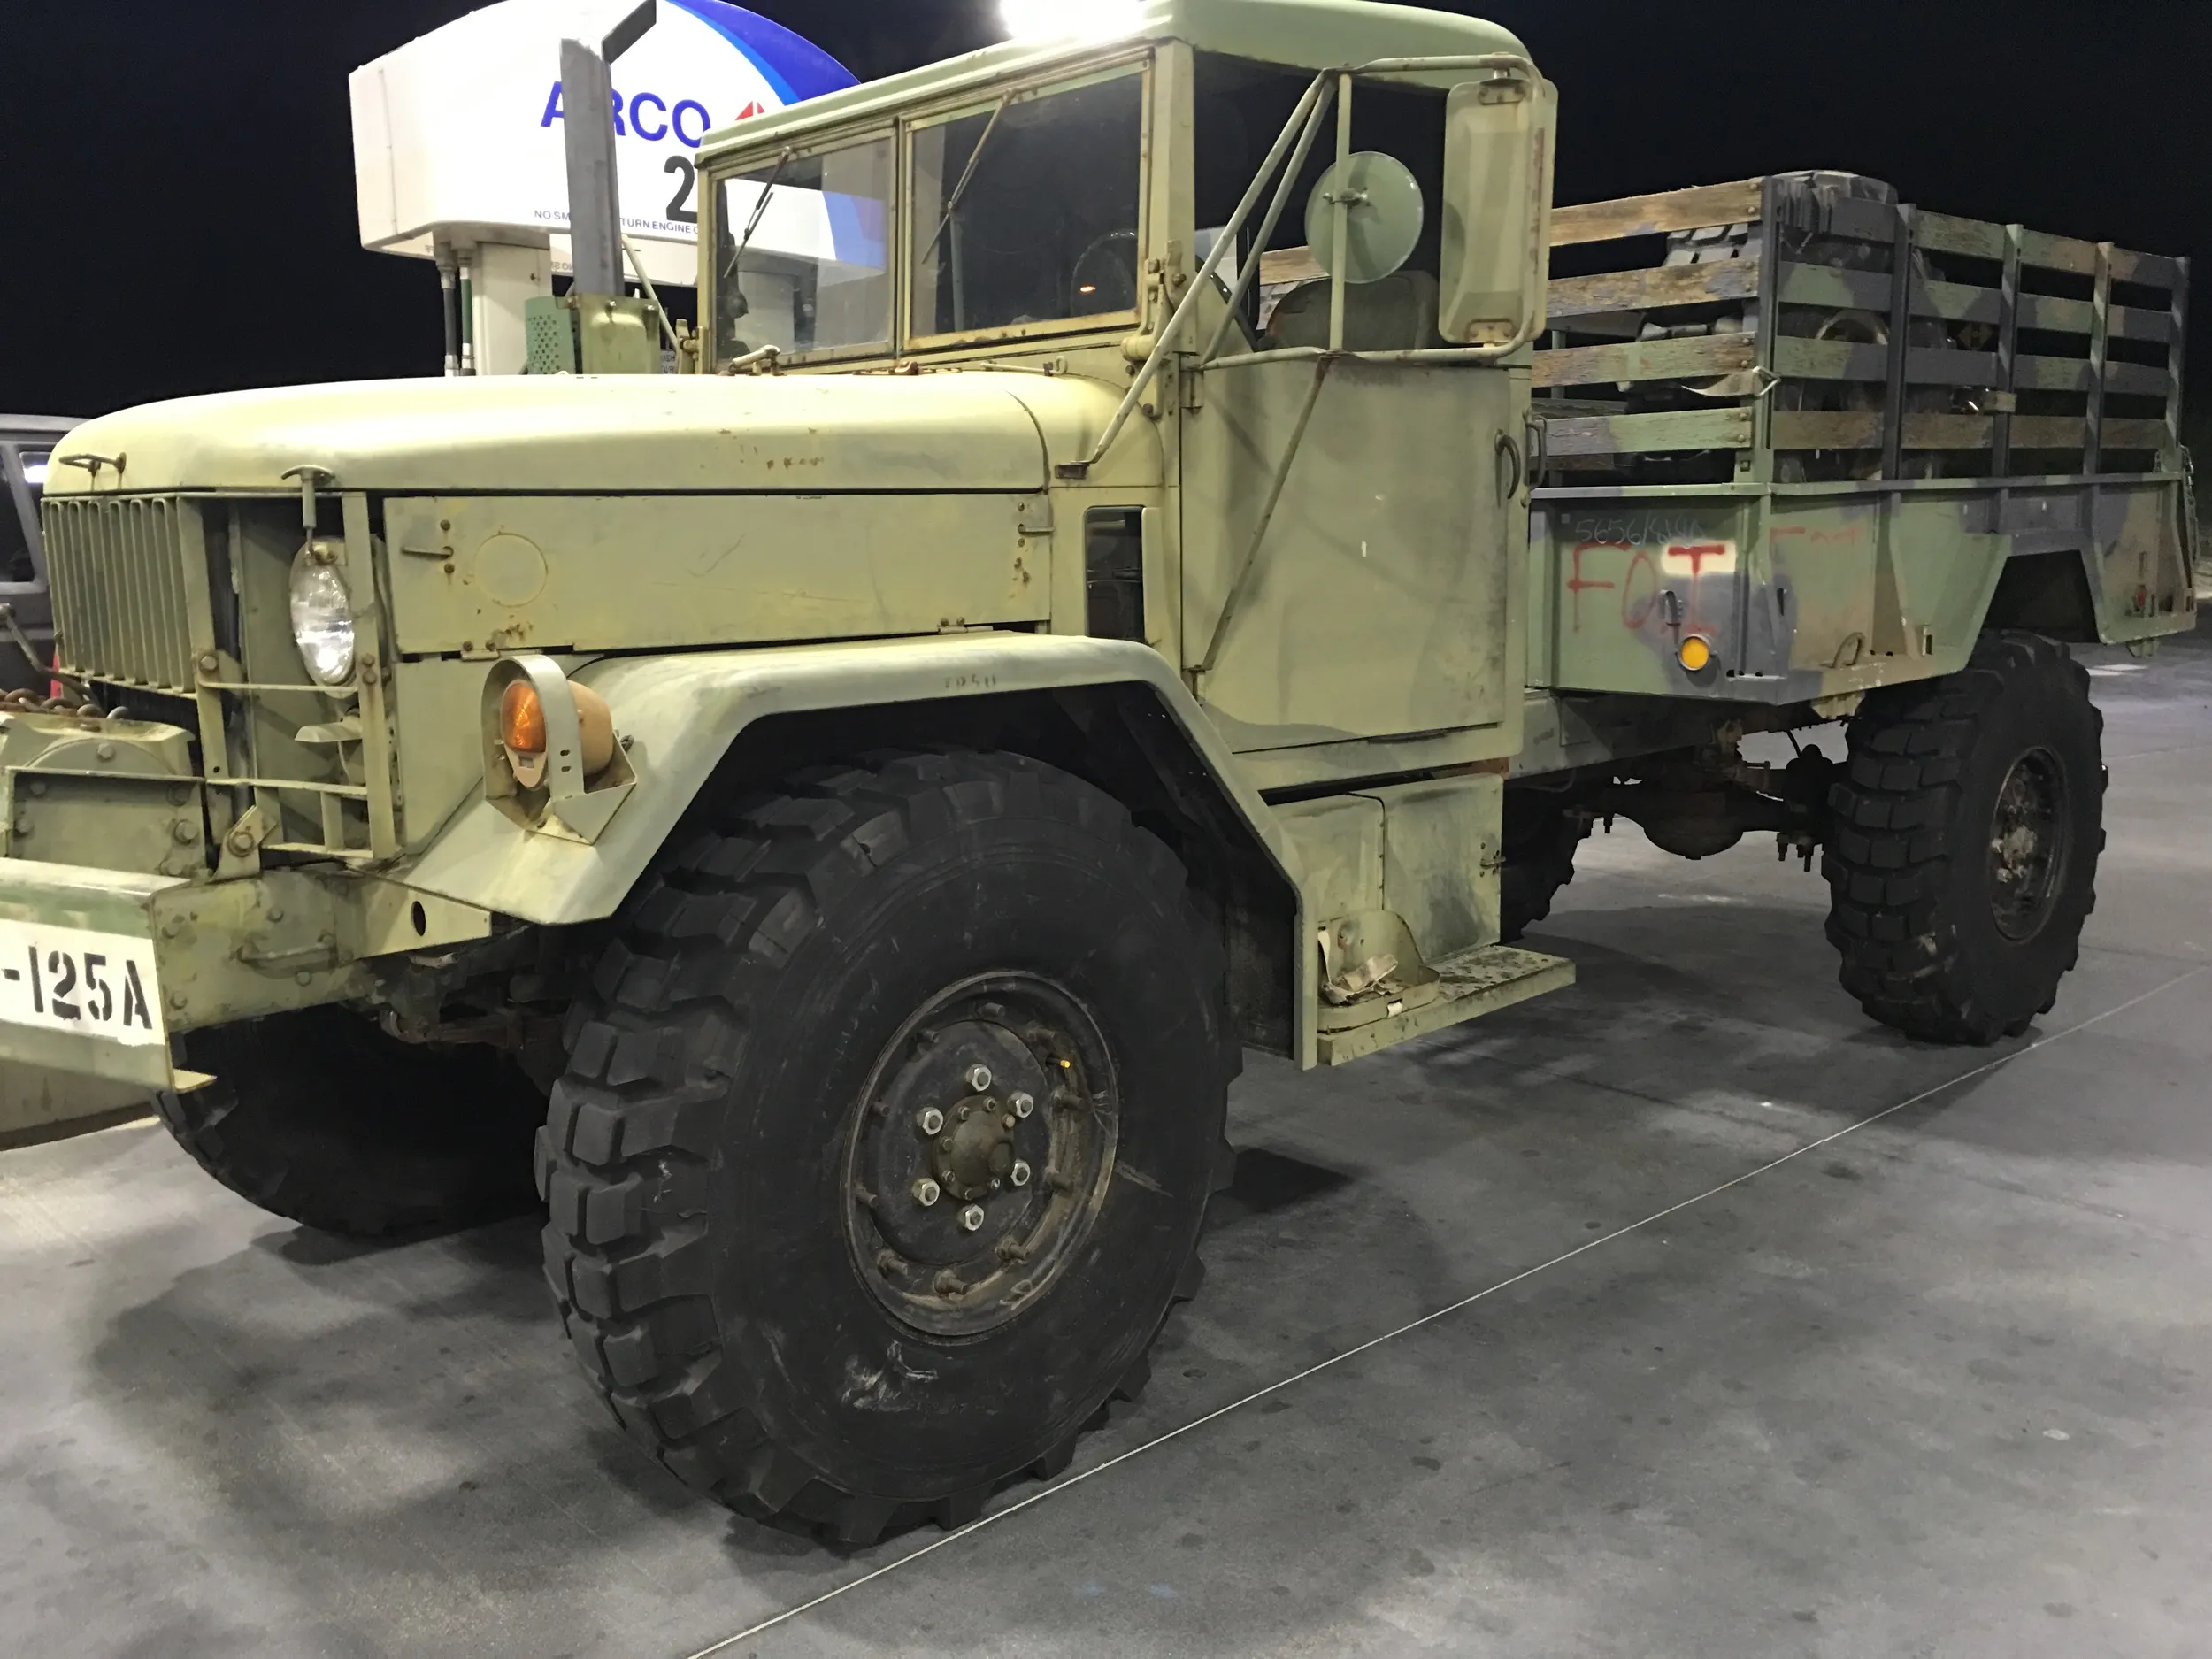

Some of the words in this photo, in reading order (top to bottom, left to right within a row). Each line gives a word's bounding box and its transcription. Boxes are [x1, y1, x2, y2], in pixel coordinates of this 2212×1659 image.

[664, 155, 697, 224] 2
[534, 210, 551, 219] NO
[620, 218, 650, 228] TURN
[652, 221, 691, 234] ENGINE
